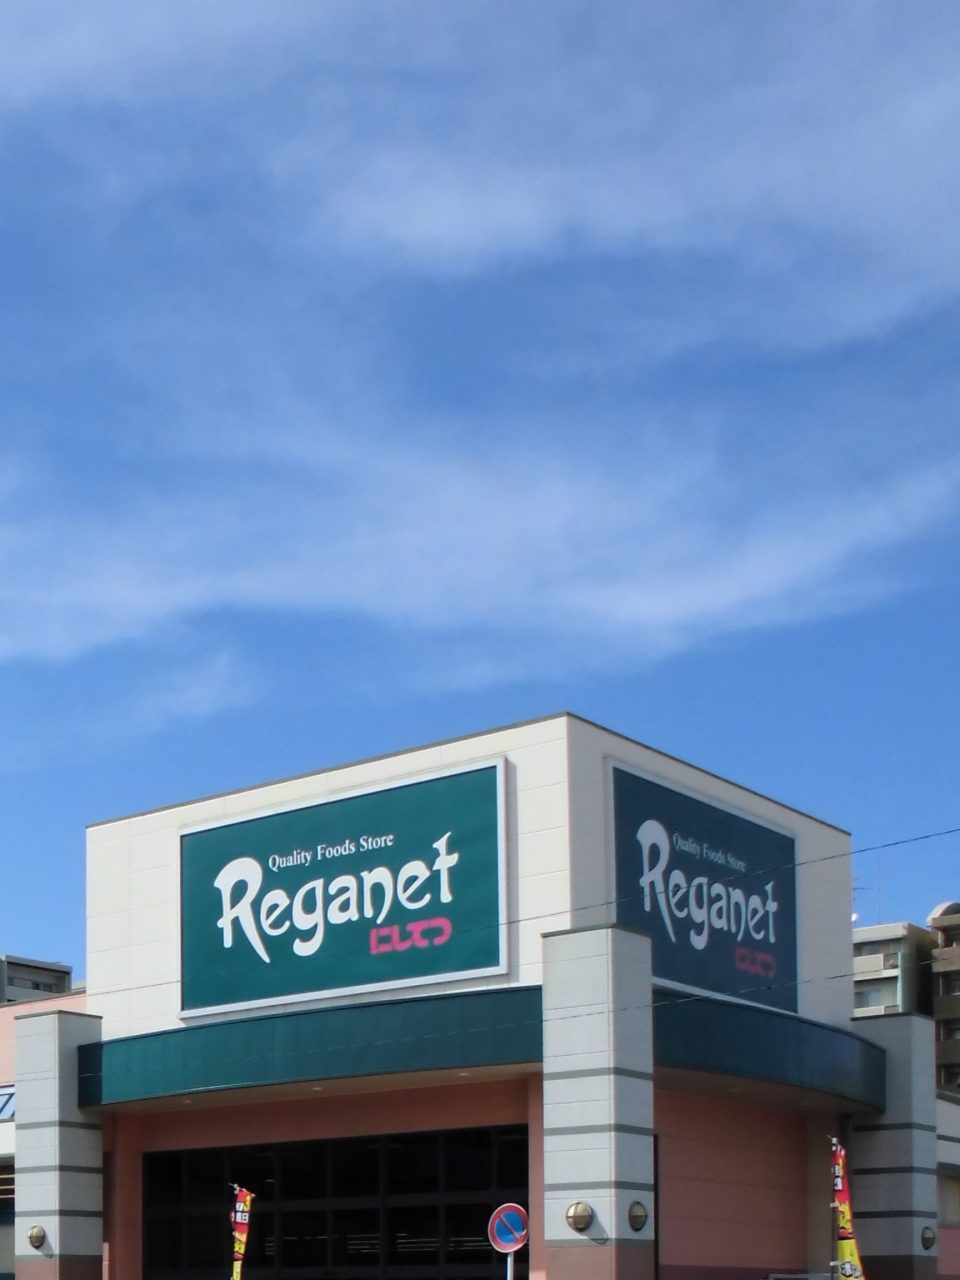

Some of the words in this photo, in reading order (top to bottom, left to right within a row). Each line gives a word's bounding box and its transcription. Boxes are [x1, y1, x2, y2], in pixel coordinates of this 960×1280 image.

[268, 848, 312, 871] Quality
[317, 840, 355, 860] Foods
[360, 833, 394, 852] Store
[636, 819, 778, 950] Reganet
[673, 832, 701, 860] Quality
[703, 844, 725, 865] Foods
[727, 852, 746, 873] Store
[214, 832, 459, 963] Reganet
